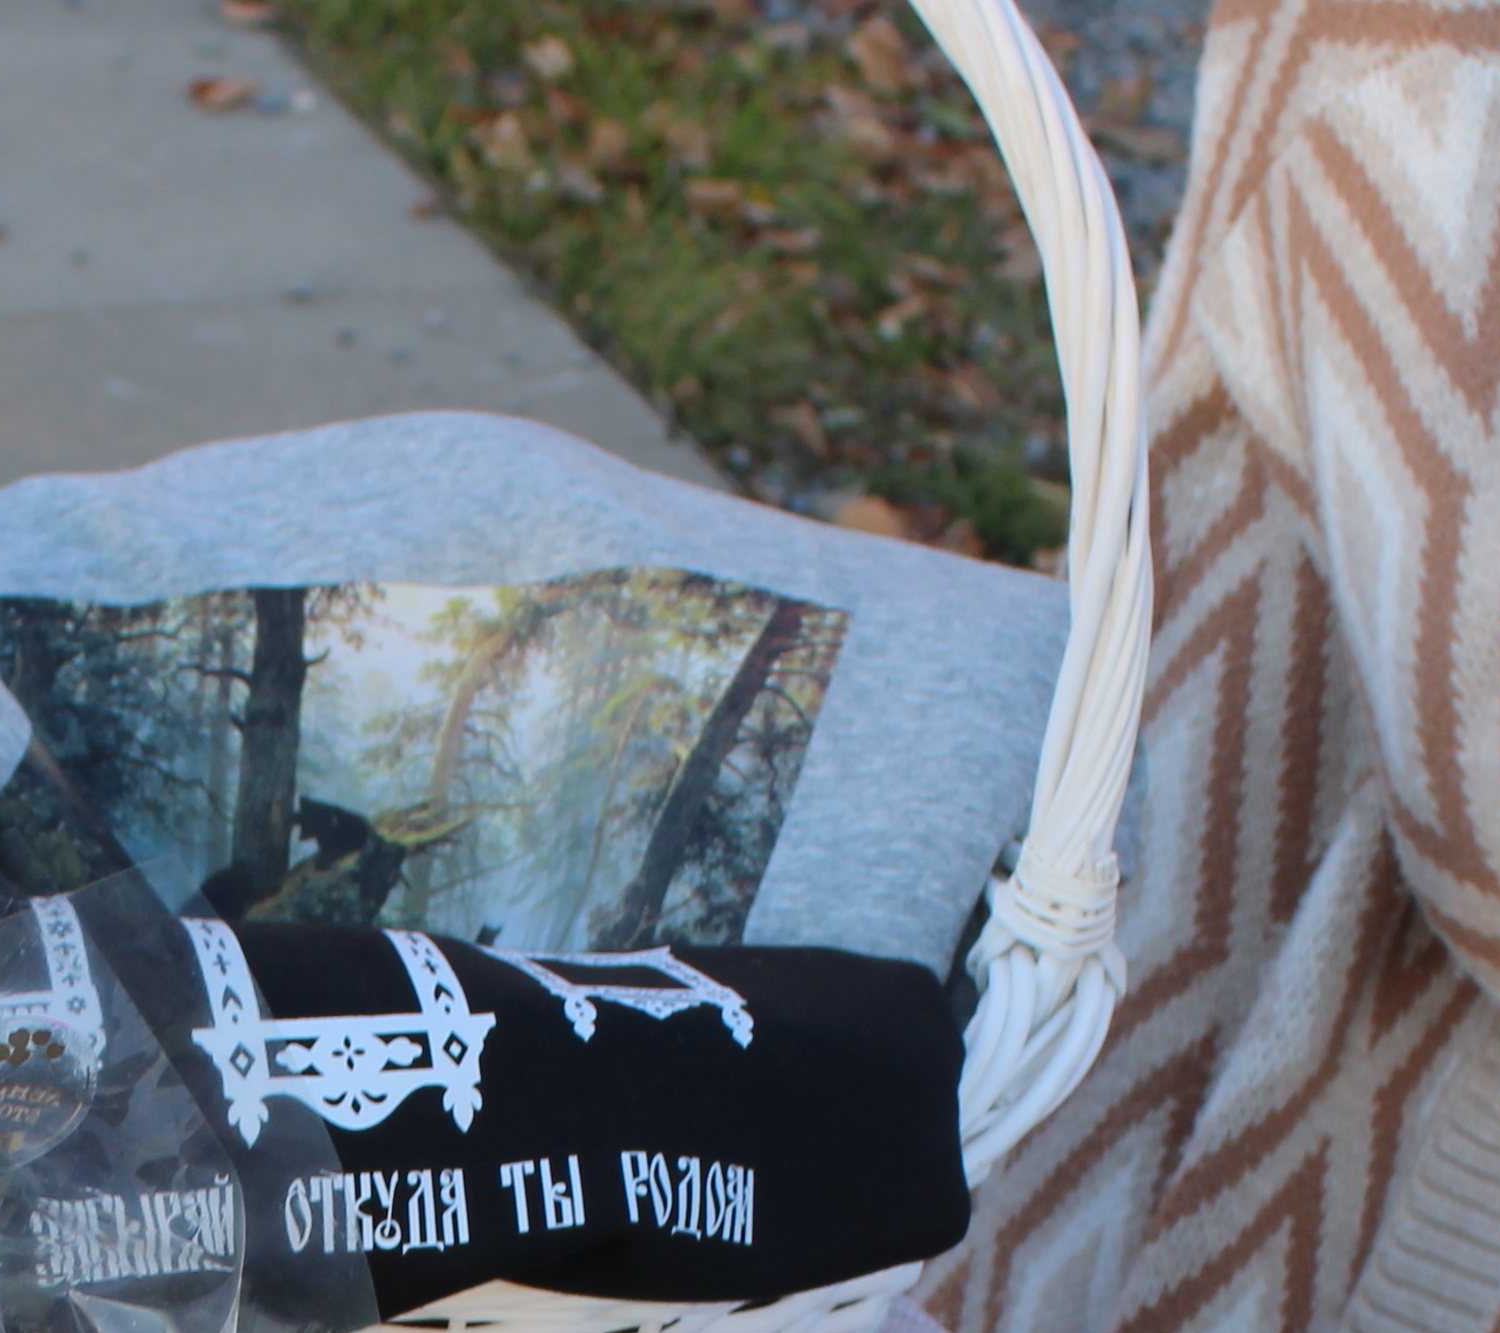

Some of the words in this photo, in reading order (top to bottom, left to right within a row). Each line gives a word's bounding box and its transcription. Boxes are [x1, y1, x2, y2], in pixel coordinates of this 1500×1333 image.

[285, 1167, 469, 1254] ОТКУДА
[500, 1154, 585, 1234] ТЫ
[620, 1150, 754, 1246] РОДОМ
